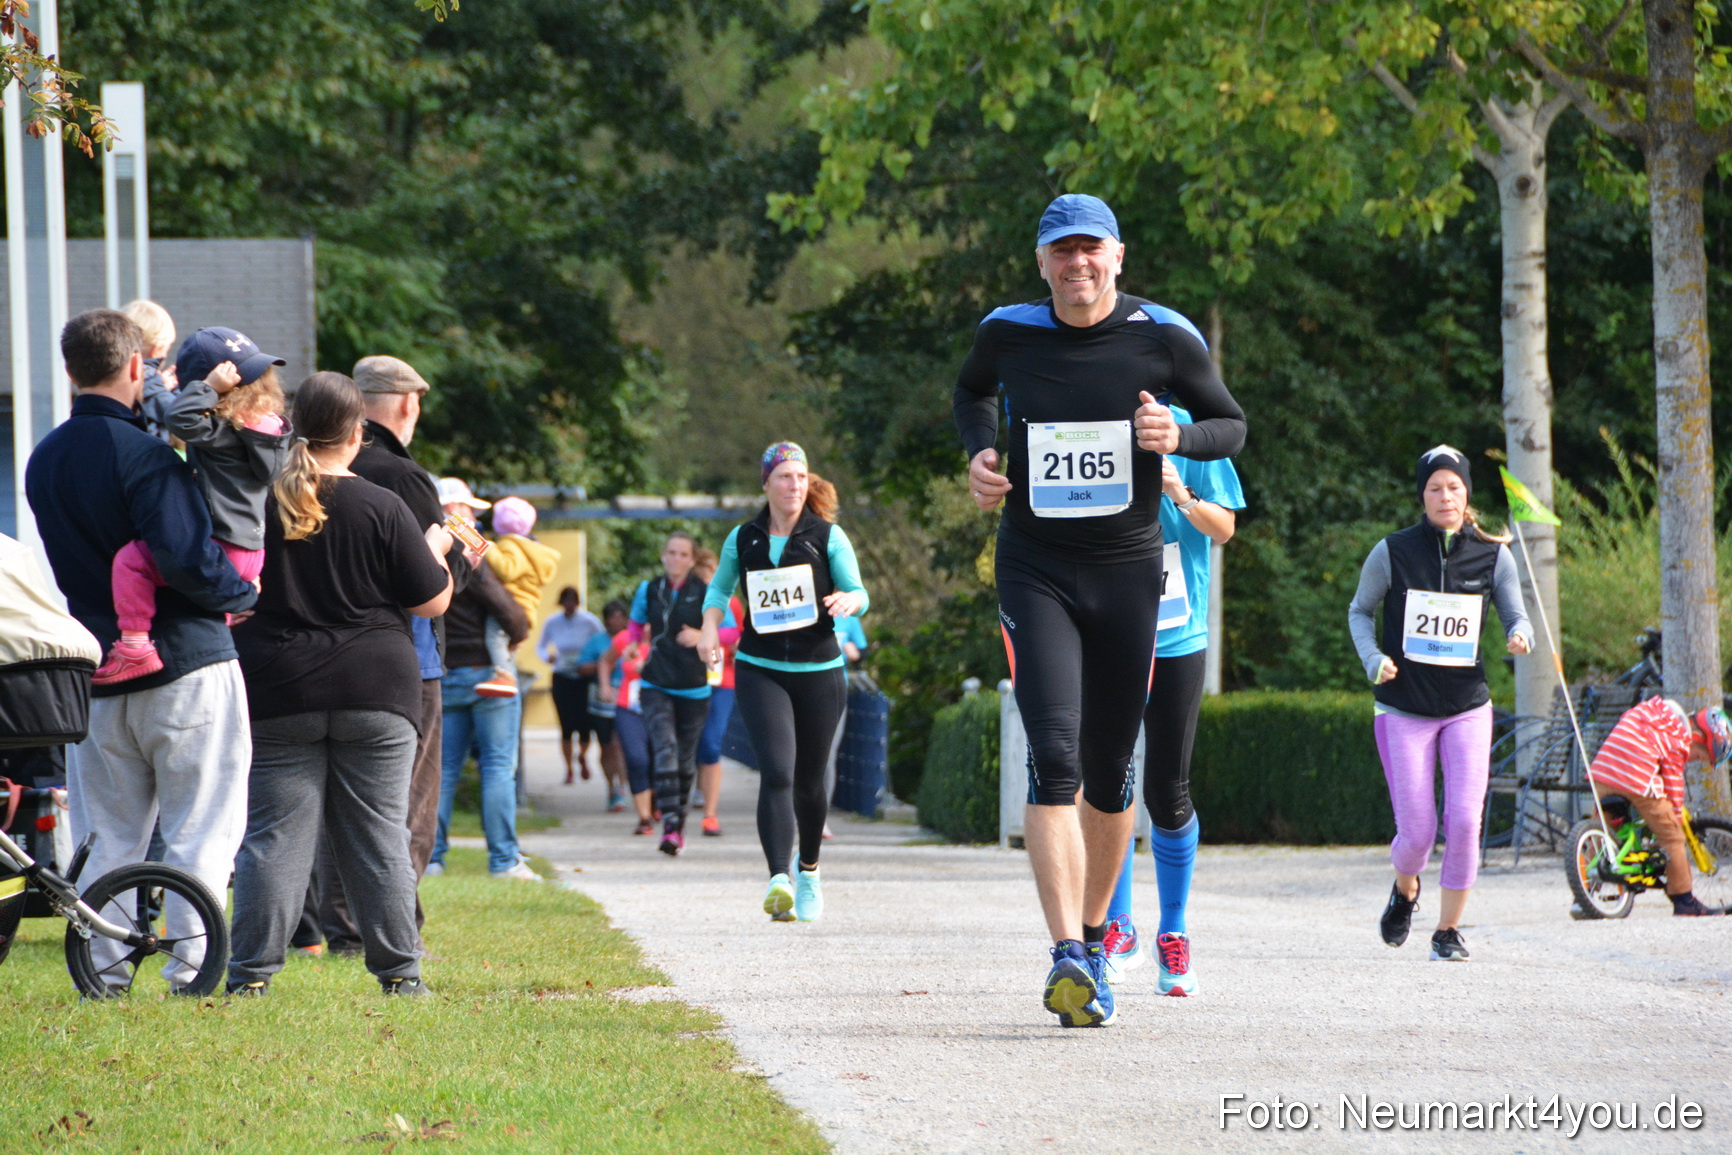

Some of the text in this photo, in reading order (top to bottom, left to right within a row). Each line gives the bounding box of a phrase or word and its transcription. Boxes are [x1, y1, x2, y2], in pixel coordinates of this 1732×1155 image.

[1043, 452, 1115, 480] 2165
[1068, 490, 1092, 501] Jack
[758, 585, 804, 608] 2414
[1416, 614, 1469, 637] 2106
